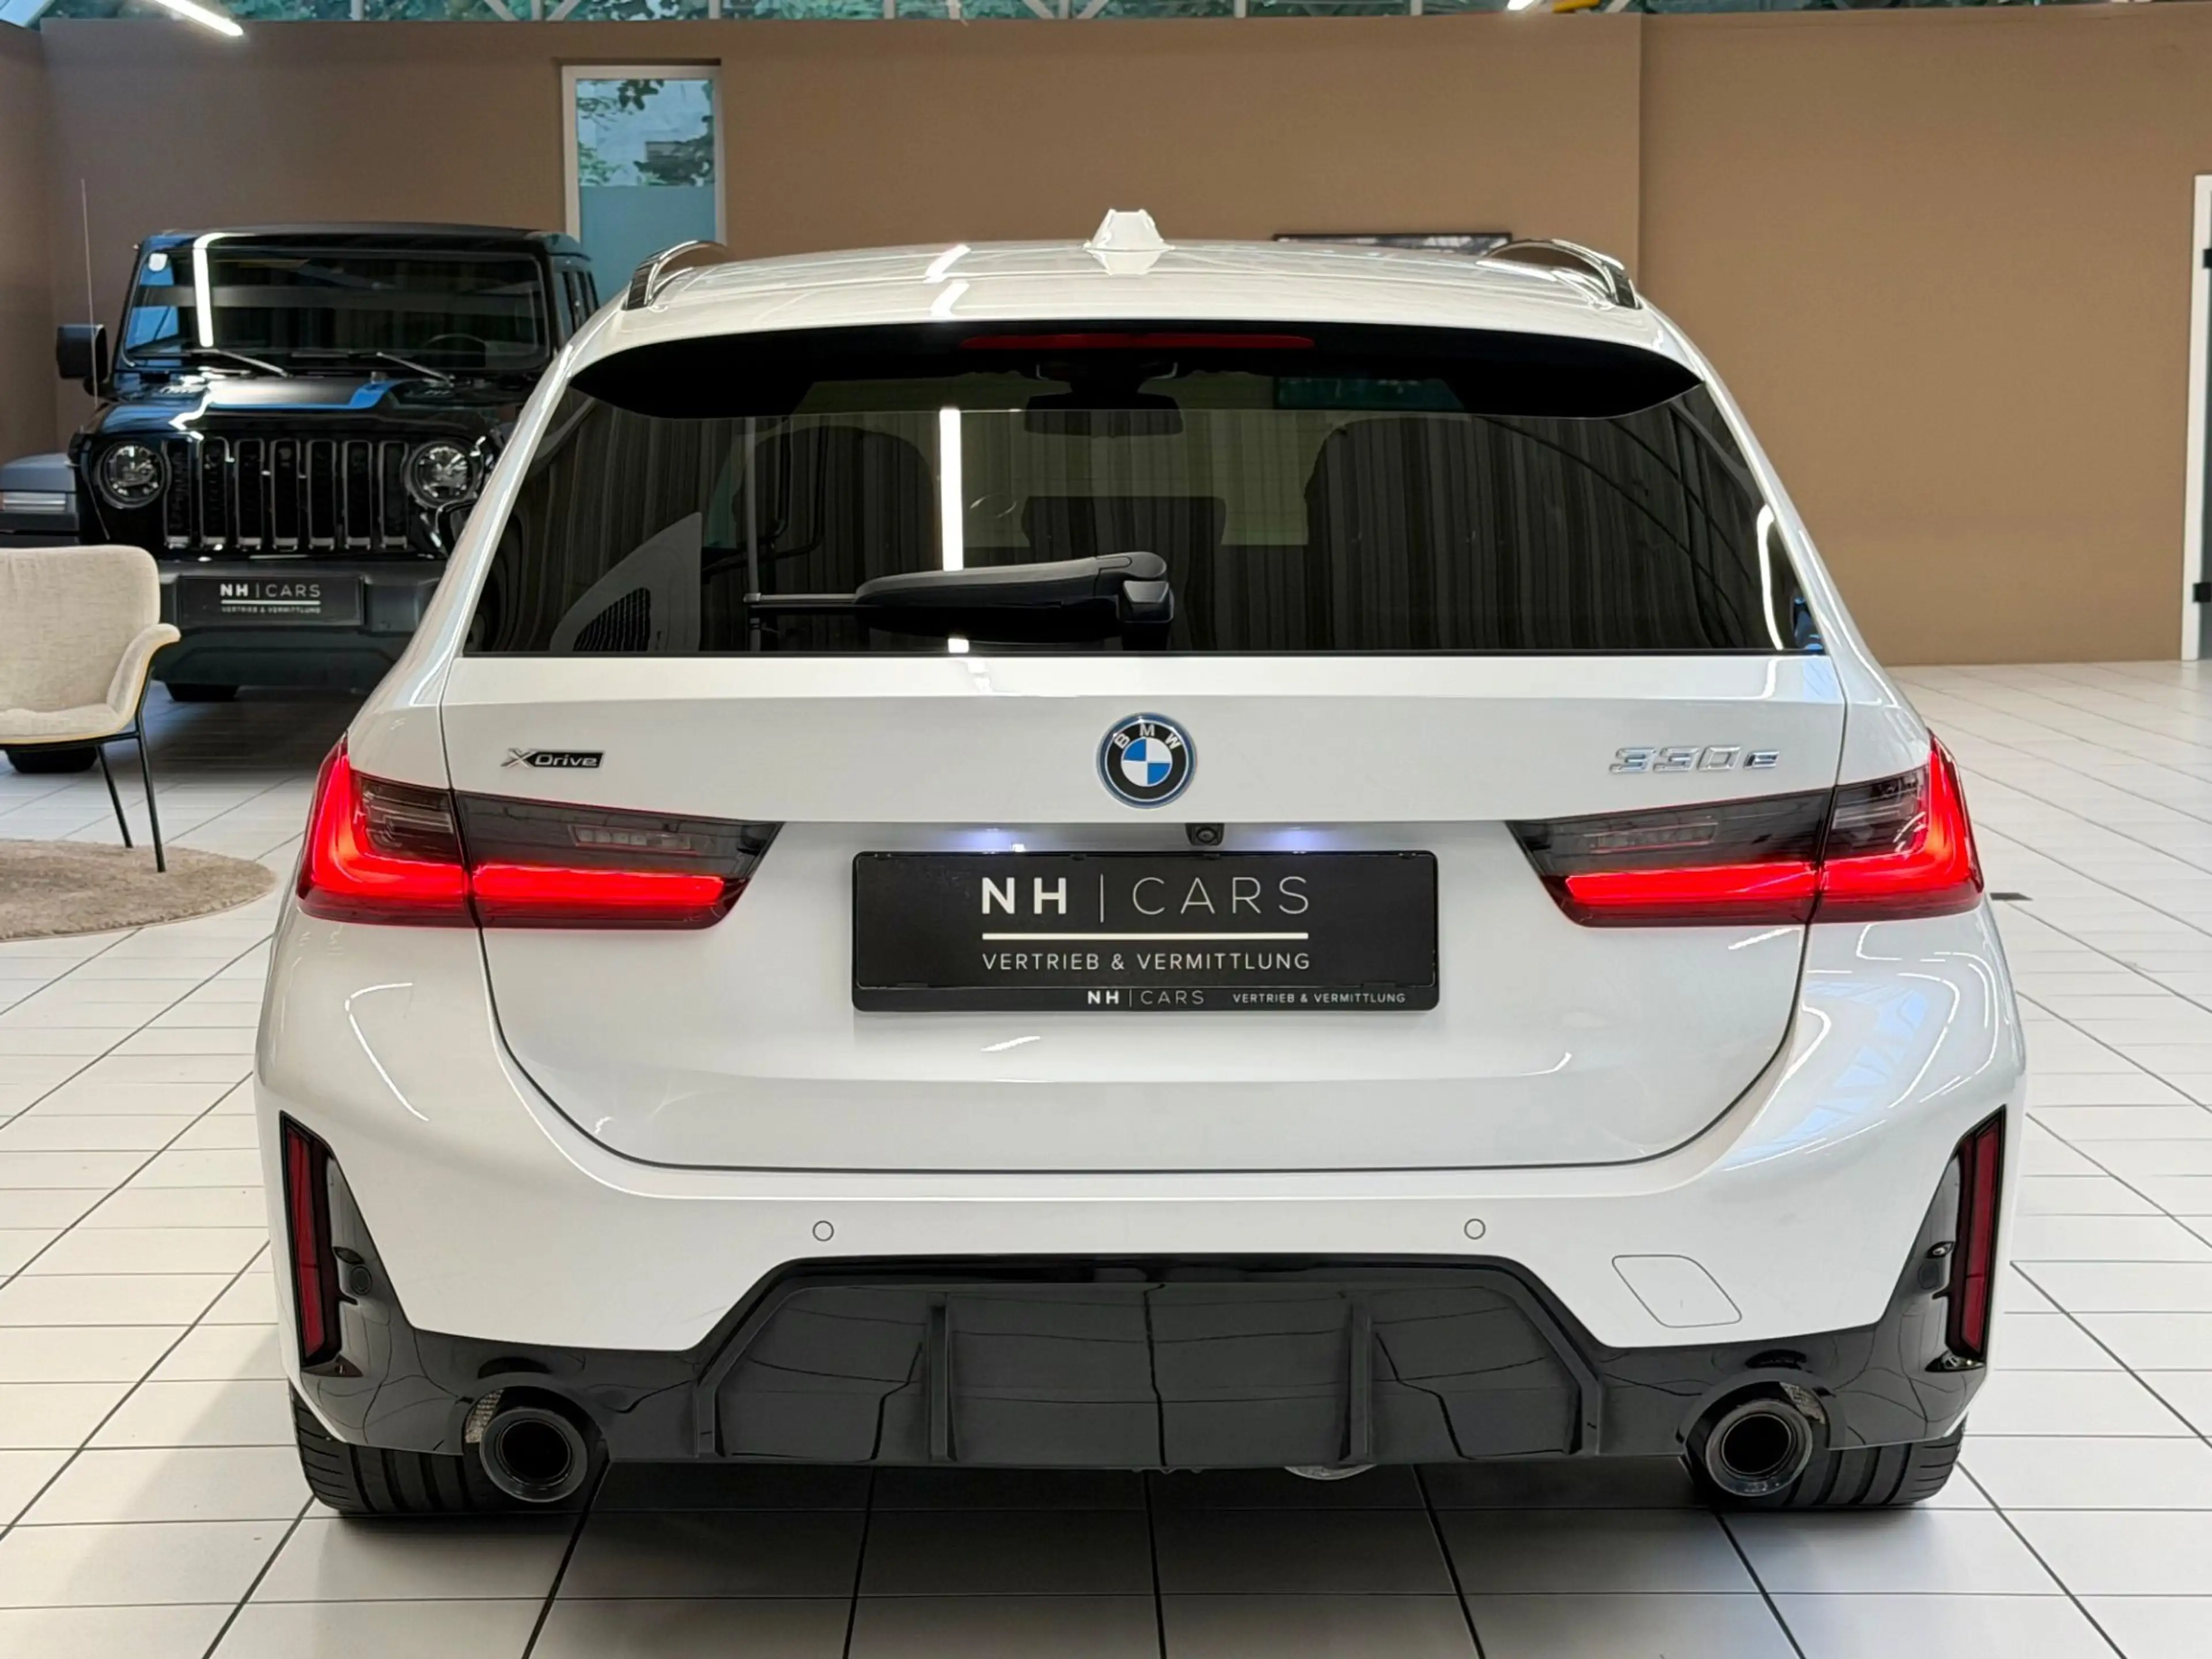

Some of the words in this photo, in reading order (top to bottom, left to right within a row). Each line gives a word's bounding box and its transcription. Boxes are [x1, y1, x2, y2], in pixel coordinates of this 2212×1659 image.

[221, 584, 248, 597] NH
[266, 584, 321, 597] CARS
[1113, 723, 1181, 749] BMW
[982, 877, 1067, 915] NH
[1132, 876, 1309, 915] CARS
[982, 953, 1099, 970] VERTRIEB
[1111, 953, 1124, 970] &
[1137, 953, 1310, 970] VERMITTLUNG
[1087, 990, 1119, 1005] NH
[1141, 990, 1205, 1005] CARS
[1233, 993, 1294, 1003] VERTRIEB
[1300, 993, 1308, 1003] &
[1313, 993, 1406, 1003] VERMITTLUNG
